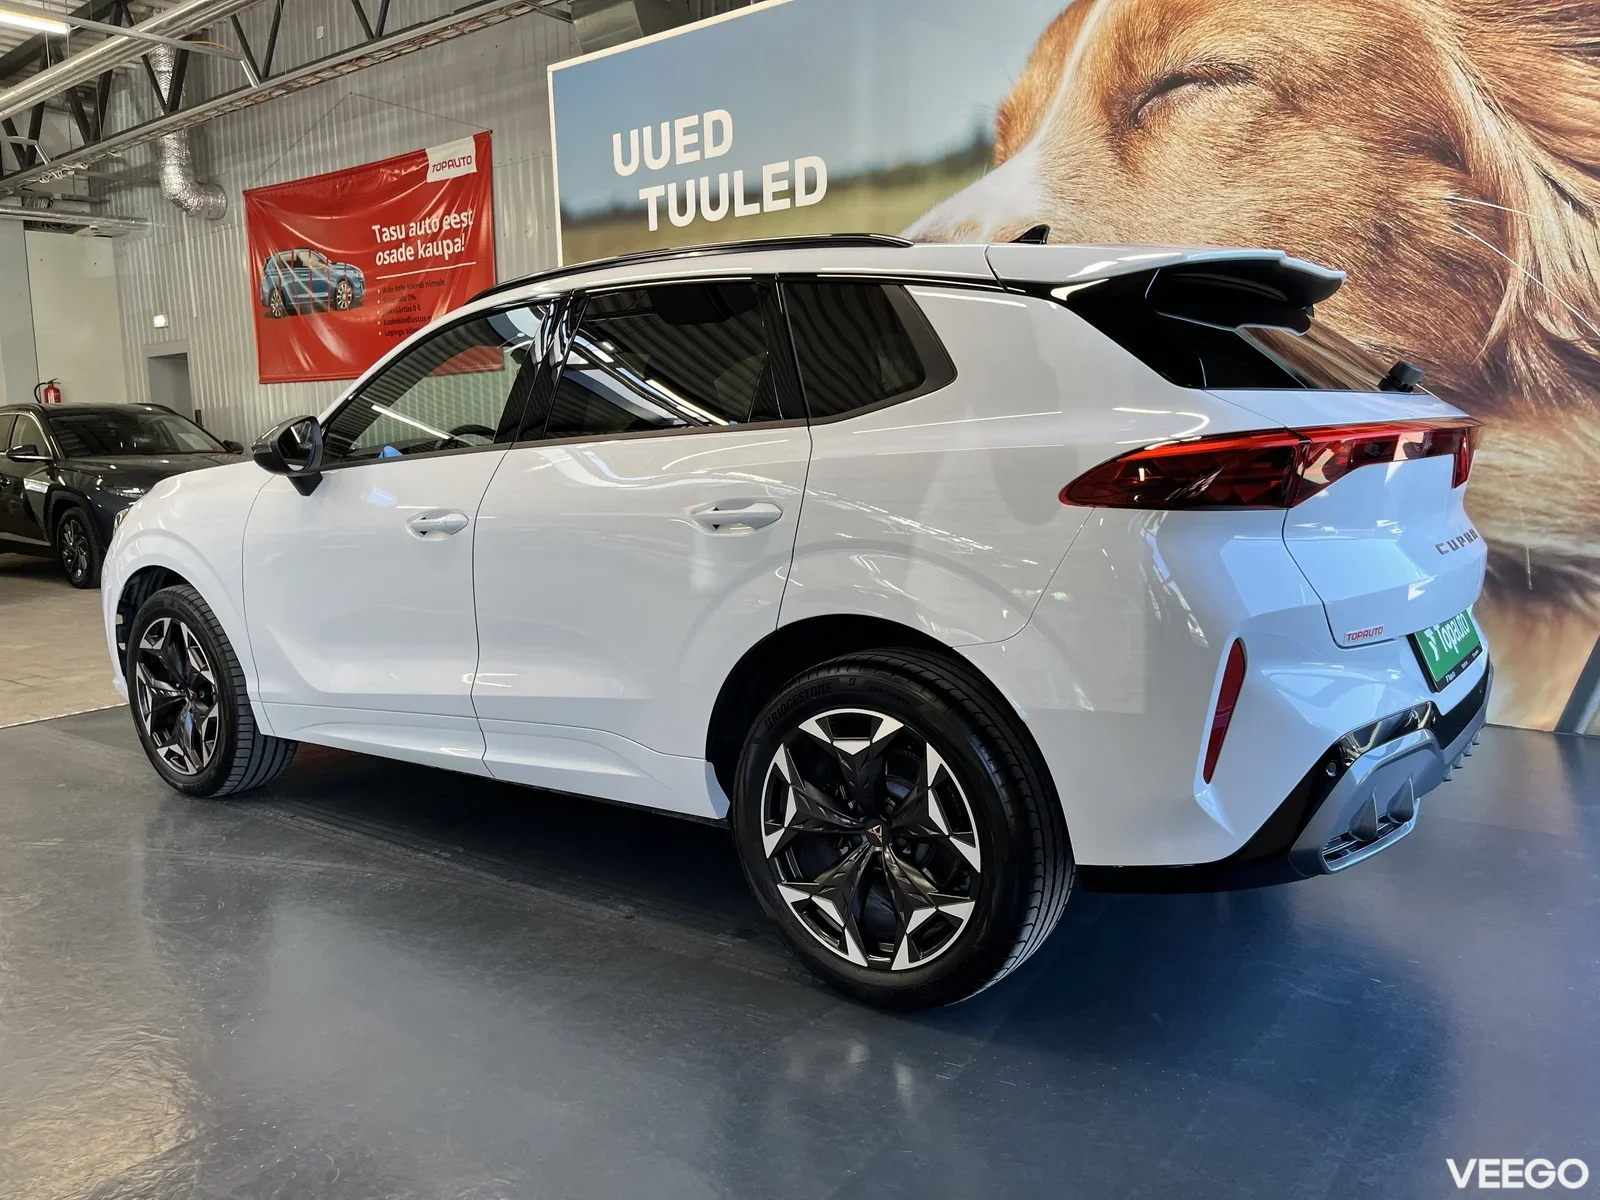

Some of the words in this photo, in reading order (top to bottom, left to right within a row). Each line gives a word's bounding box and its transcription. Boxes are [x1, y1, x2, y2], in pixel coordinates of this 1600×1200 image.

[612, 108, 734, 177] UUED
[431, 155, 473, 173] TOPAUTO
[638, 155, 828, 232] TUULED
[371, 223, 406, 244] Tasu
[408, 216, 440, 238] auto
[442, 208, 474, 231] eest
[375, 242, 415, 266] osade
[417, 232, 465, 261] kaupa!
[1435, 528, 1479, 556] CUPRA
[1346, 626, 1384, 641] TOPAUTO
[1433, 612, 1470, 655] Topauto
[764, 681, 833, 730] BRIDGESTONE
